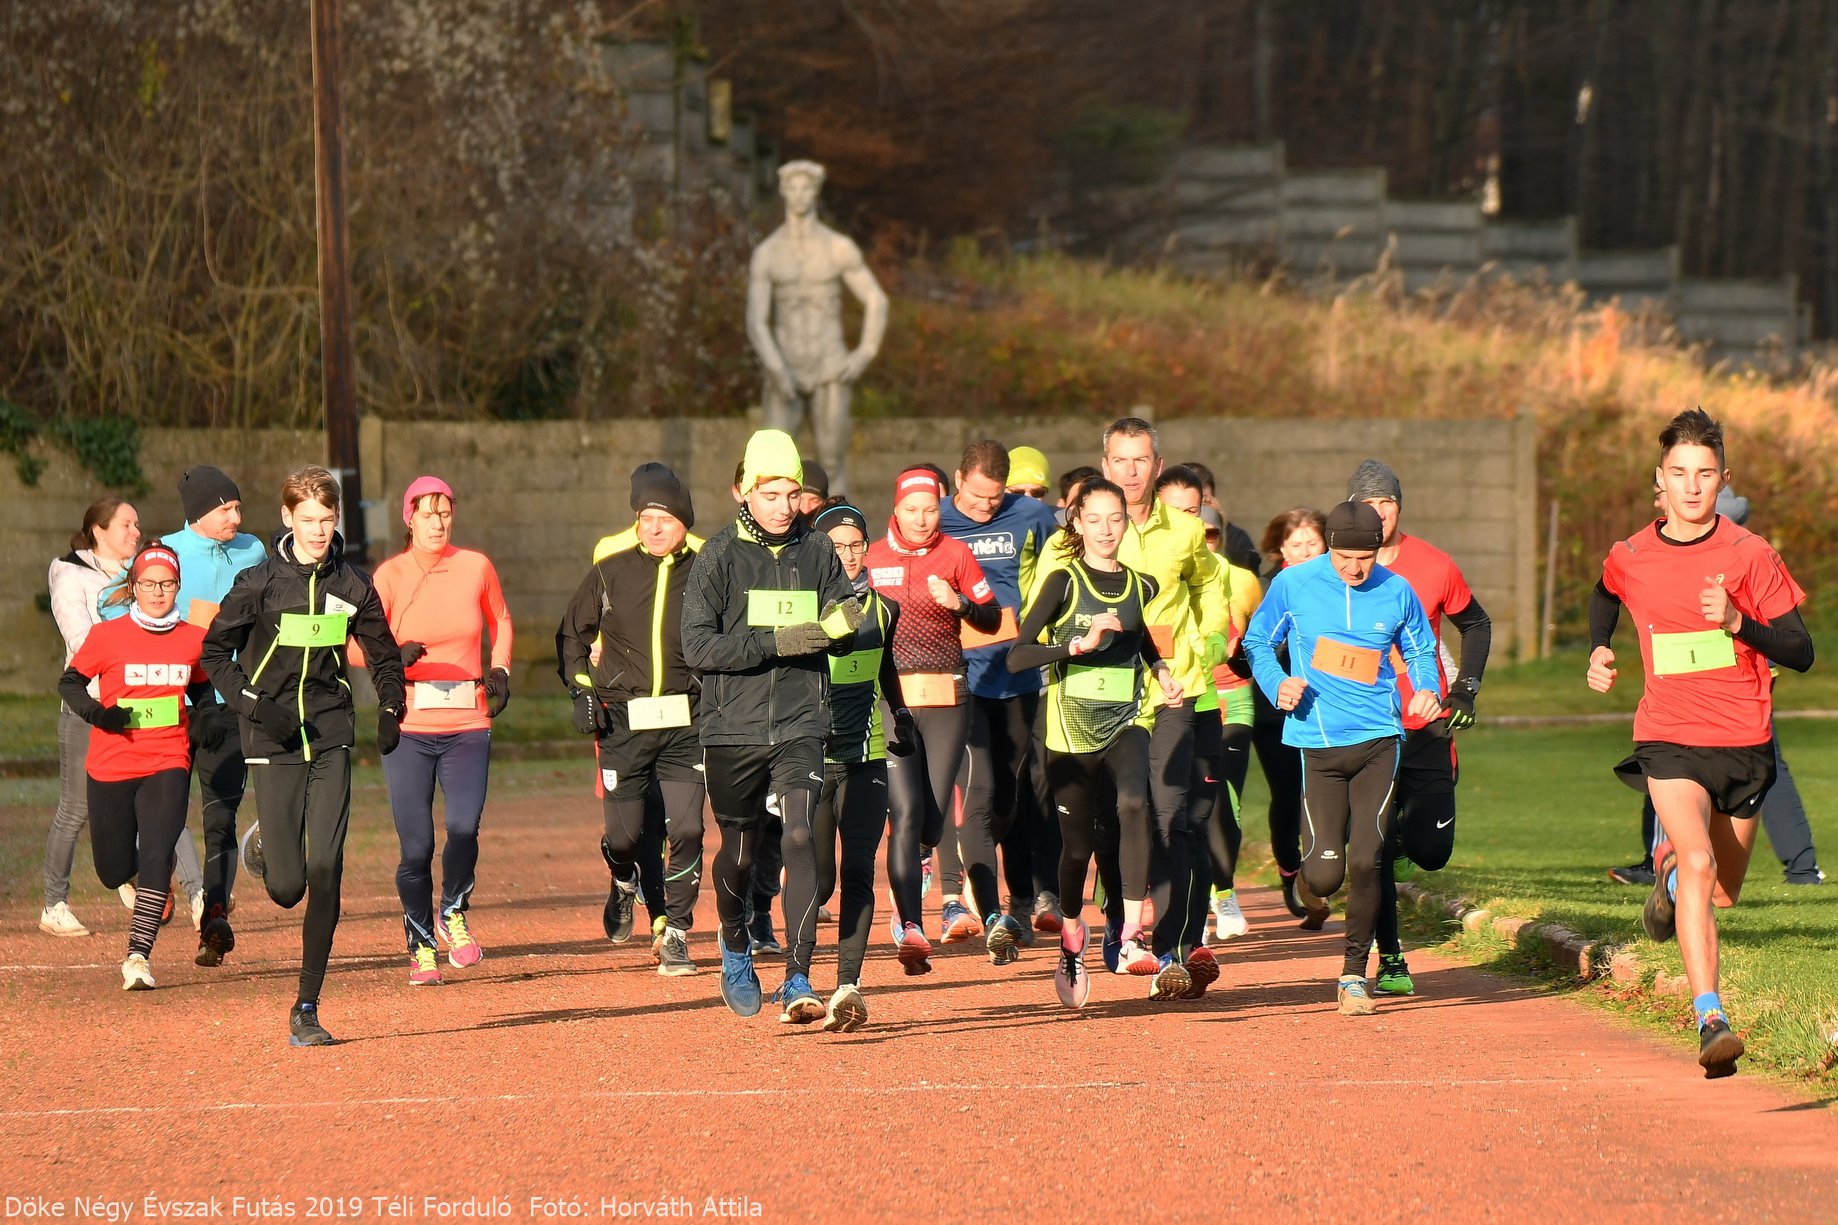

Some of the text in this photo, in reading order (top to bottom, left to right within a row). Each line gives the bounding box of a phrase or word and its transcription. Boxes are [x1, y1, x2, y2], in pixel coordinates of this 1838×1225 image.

[777, 600, 793, 615] 12
[311, 623, 320, 636] 9
[1340, 655, 1355, 669] 11
[1690, 649, 1696, 664] 1
[849, 660, 858, 673] 3
[1097, 677, 1105, 691] 2
[145, 707, 153, 719] 8
